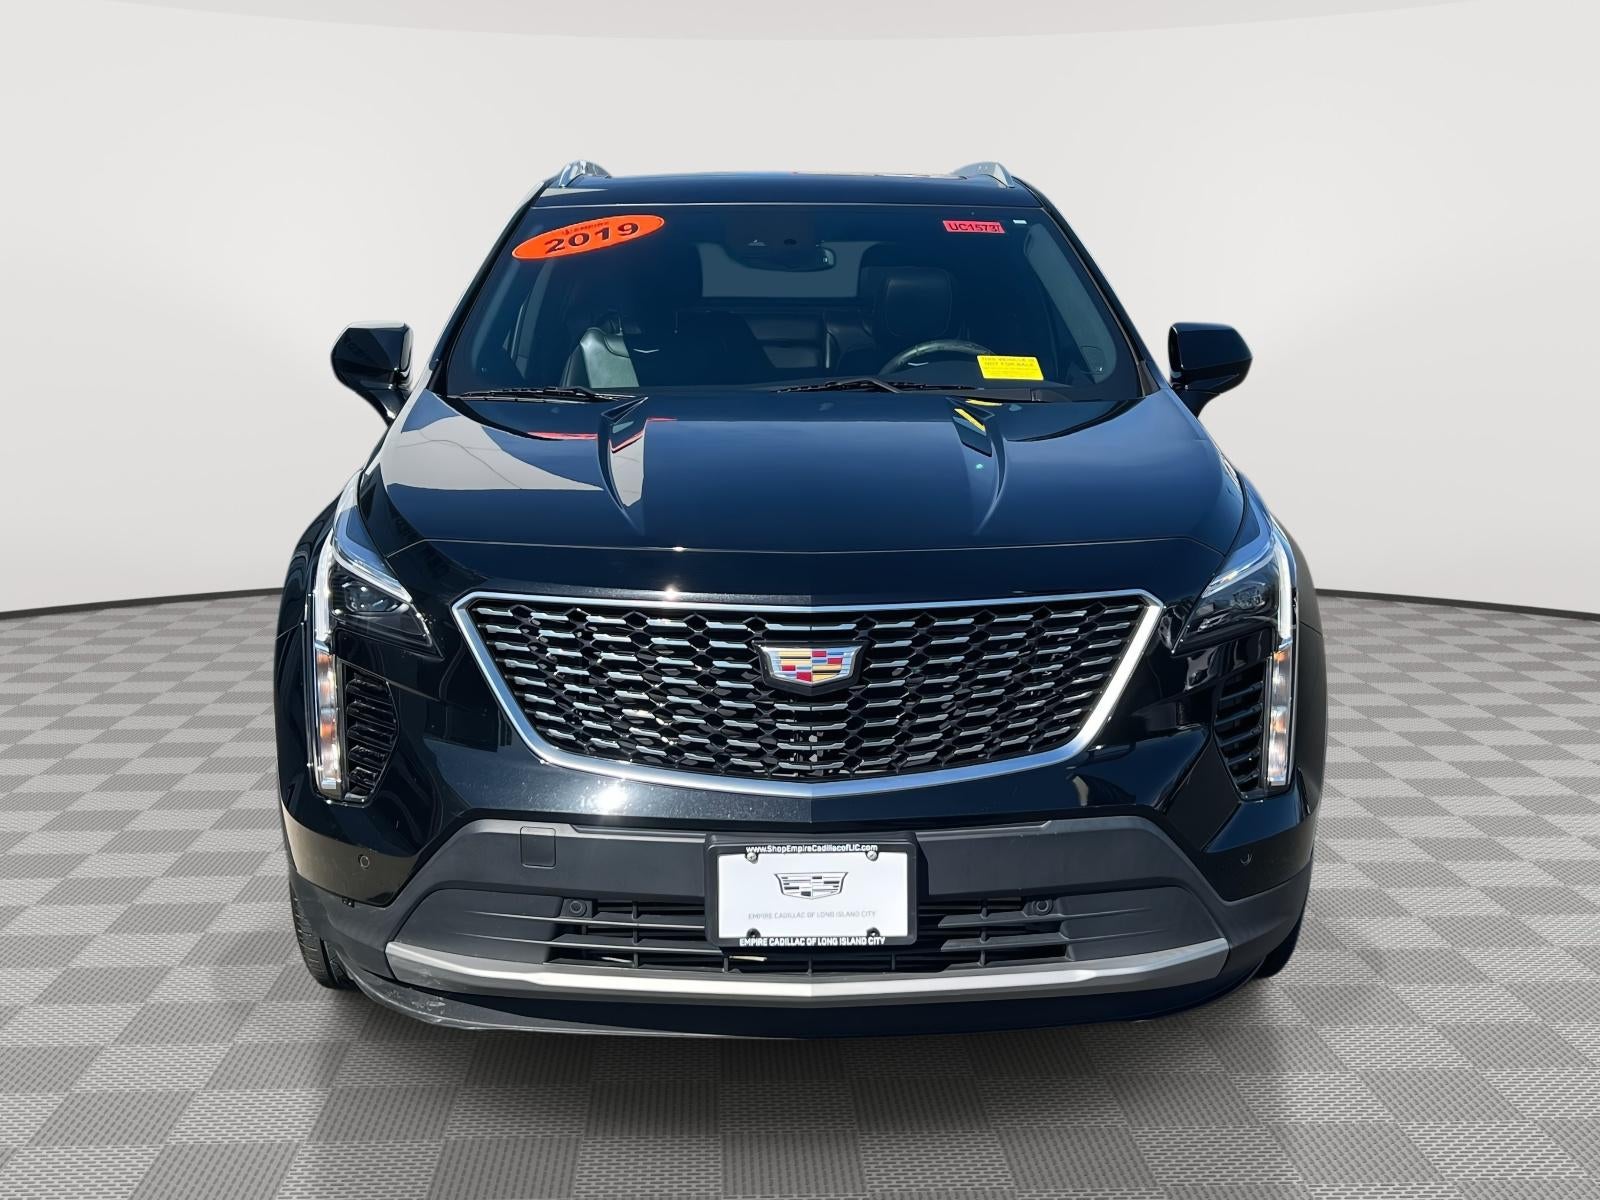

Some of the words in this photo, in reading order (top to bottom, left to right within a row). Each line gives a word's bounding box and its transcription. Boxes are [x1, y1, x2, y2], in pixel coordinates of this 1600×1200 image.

[544, 222, 639, 254] 2019
[748, 912, 772, 920] EMPIRE
[774, 912, 806, 920] CADILLAC
[807, 911, 815, 919] OF
[816, 911, 835, 919] LONG
[861, 910, 876, 918] CITY
[739, 938, 768, 947] EMPIRE
[769, 938, 806, 947] CADILLAC
[806, 937, 817, 946] OF
[817, 937, 838, 946] LONG
[839, 937, 867, 946] ISLAND
[868, 936, 886, 945] CITY
